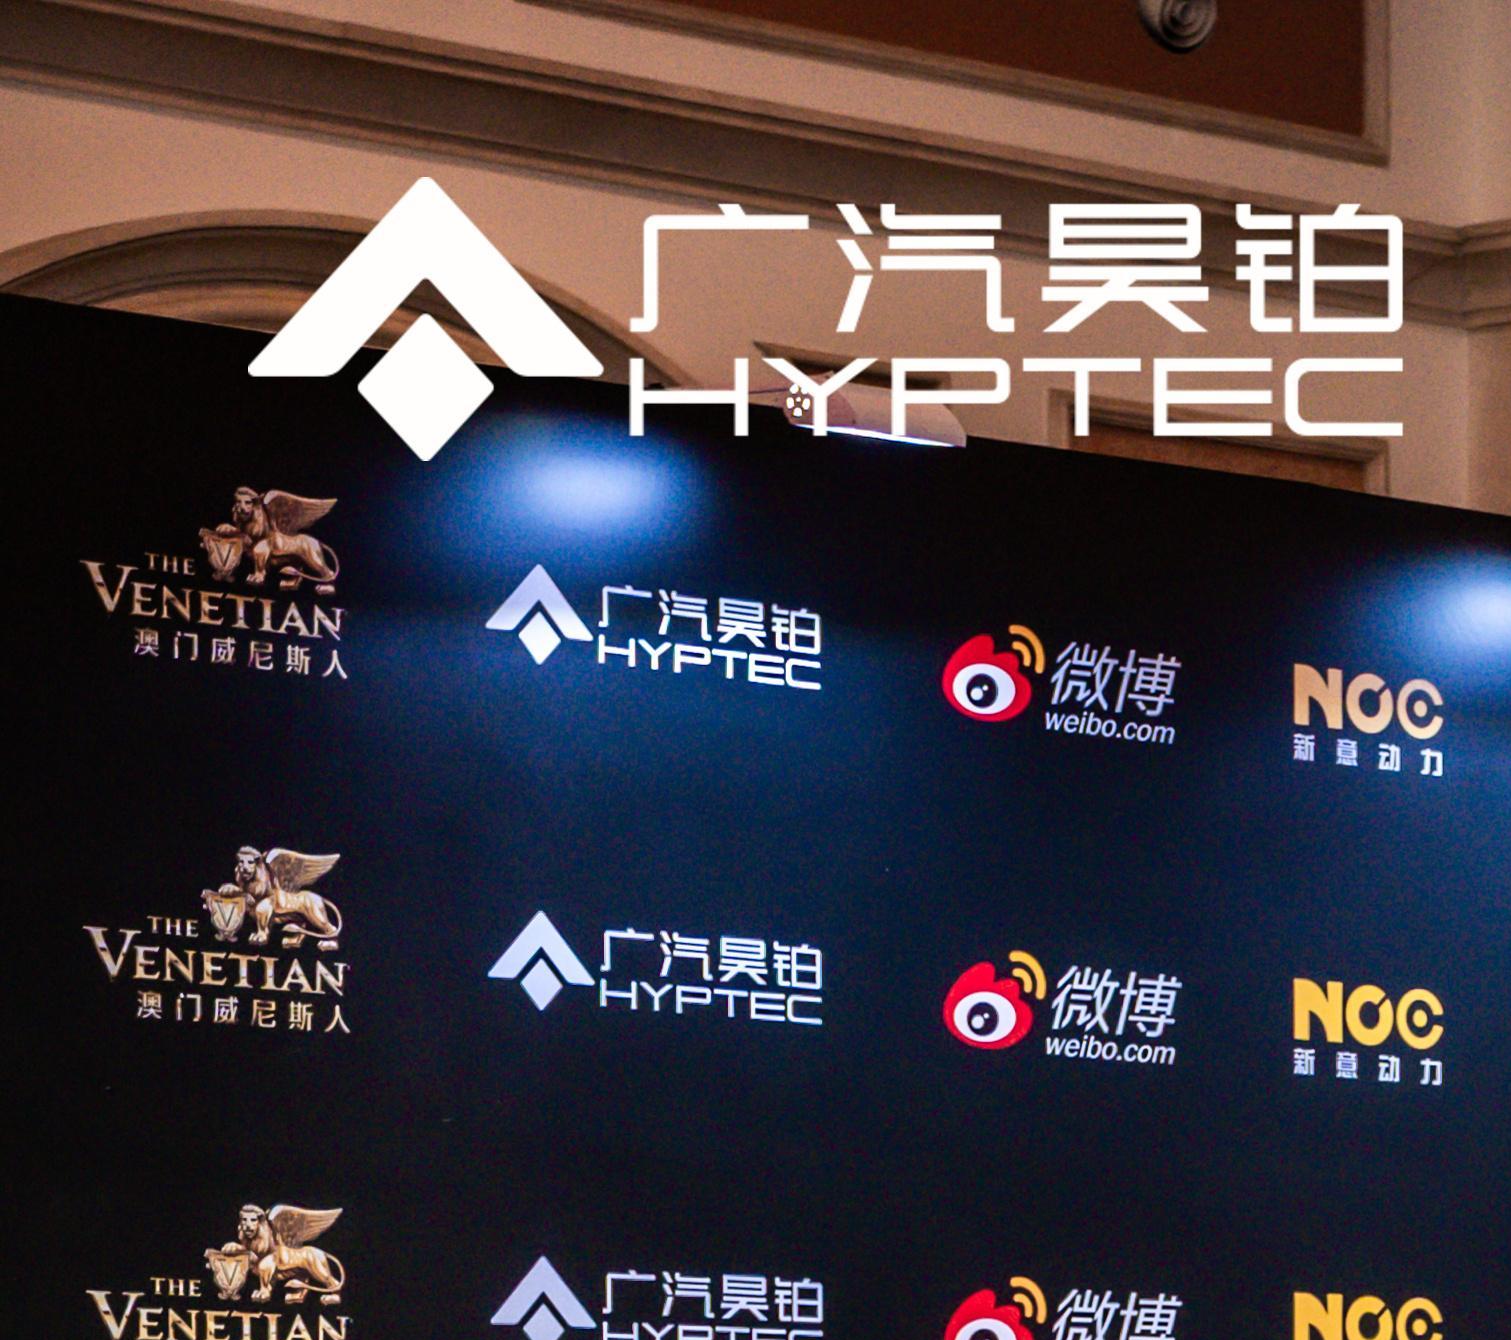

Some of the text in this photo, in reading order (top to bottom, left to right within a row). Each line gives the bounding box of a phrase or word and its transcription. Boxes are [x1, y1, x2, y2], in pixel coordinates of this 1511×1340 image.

[149, 554, 194, 575] THE
[82, 555, 344, 640] VENETIAN
[598, 585, 821, 660] 广汽昊铂
[135, 629, 347, 679] 澳门威尼斯人
[598, 634, 821, 690] HYPTEC
[1051, 642, 1181, 716] 微博
[1046, 711, 1175, 744] weibo.com
[1294, 664, 1442, 739] NOC
[1294, 733, 1443, 776] 新意动力
[83, 923, 346, 996] VENETIAN
[600, 928, 822, 990] 广汽昊铂
[138, 991, 350, 1033] 澳门威尼斯人
[600, 978, 822, 1025] HYPTEC
[1052, 966, 1182, 1037] 微博
[1294, 978, 1443, 1049] NOC
[1046, 1035, 1175, 1064] weibo.com
[1294, 1048, 1442, 1085] 新意动力
[151, 1278, 201, 1296] THE
[603, 1270, 823, 1323] 广汽昊铂
